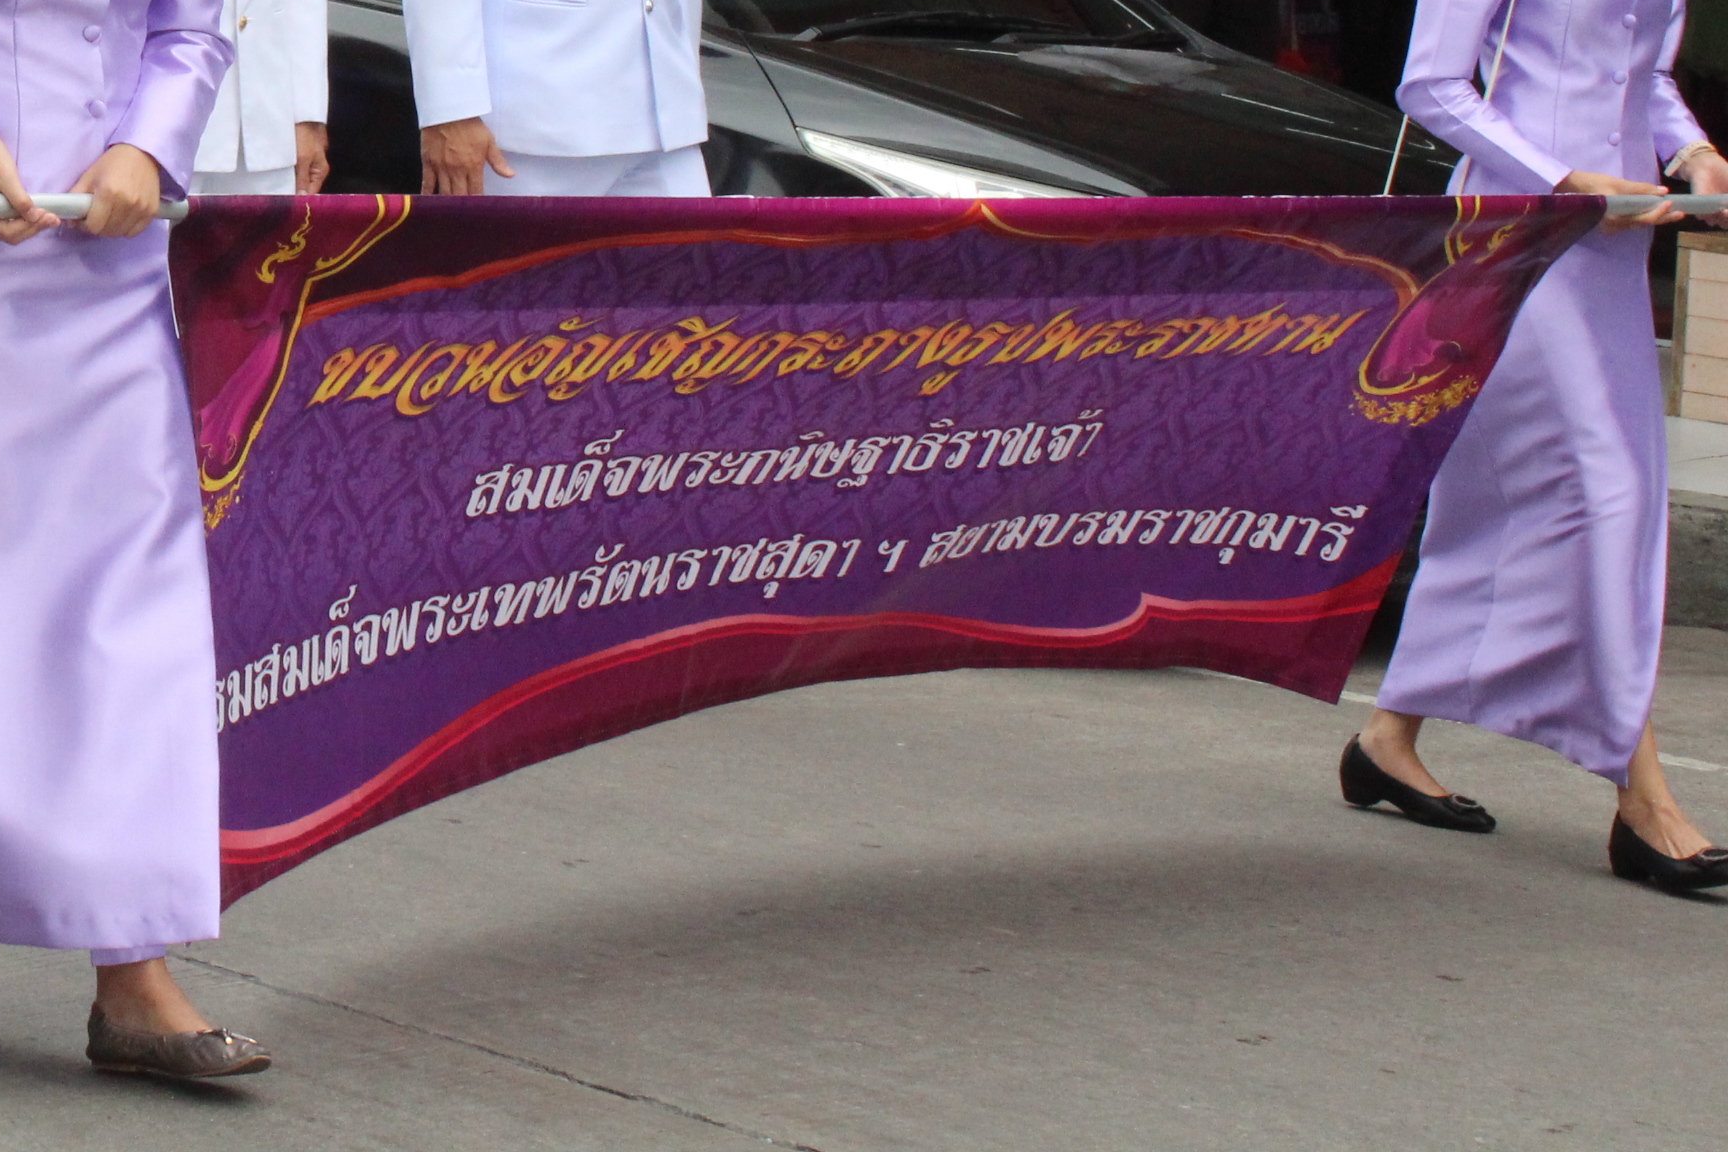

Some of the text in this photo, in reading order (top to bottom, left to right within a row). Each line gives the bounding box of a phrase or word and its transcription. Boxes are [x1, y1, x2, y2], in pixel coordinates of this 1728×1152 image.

[465, 408, 1104, 518] สมเด็จพระกนิษฐาธิราชเจ้า
[918, 504, 1369, 568] สยามบรมราชกุมารี
